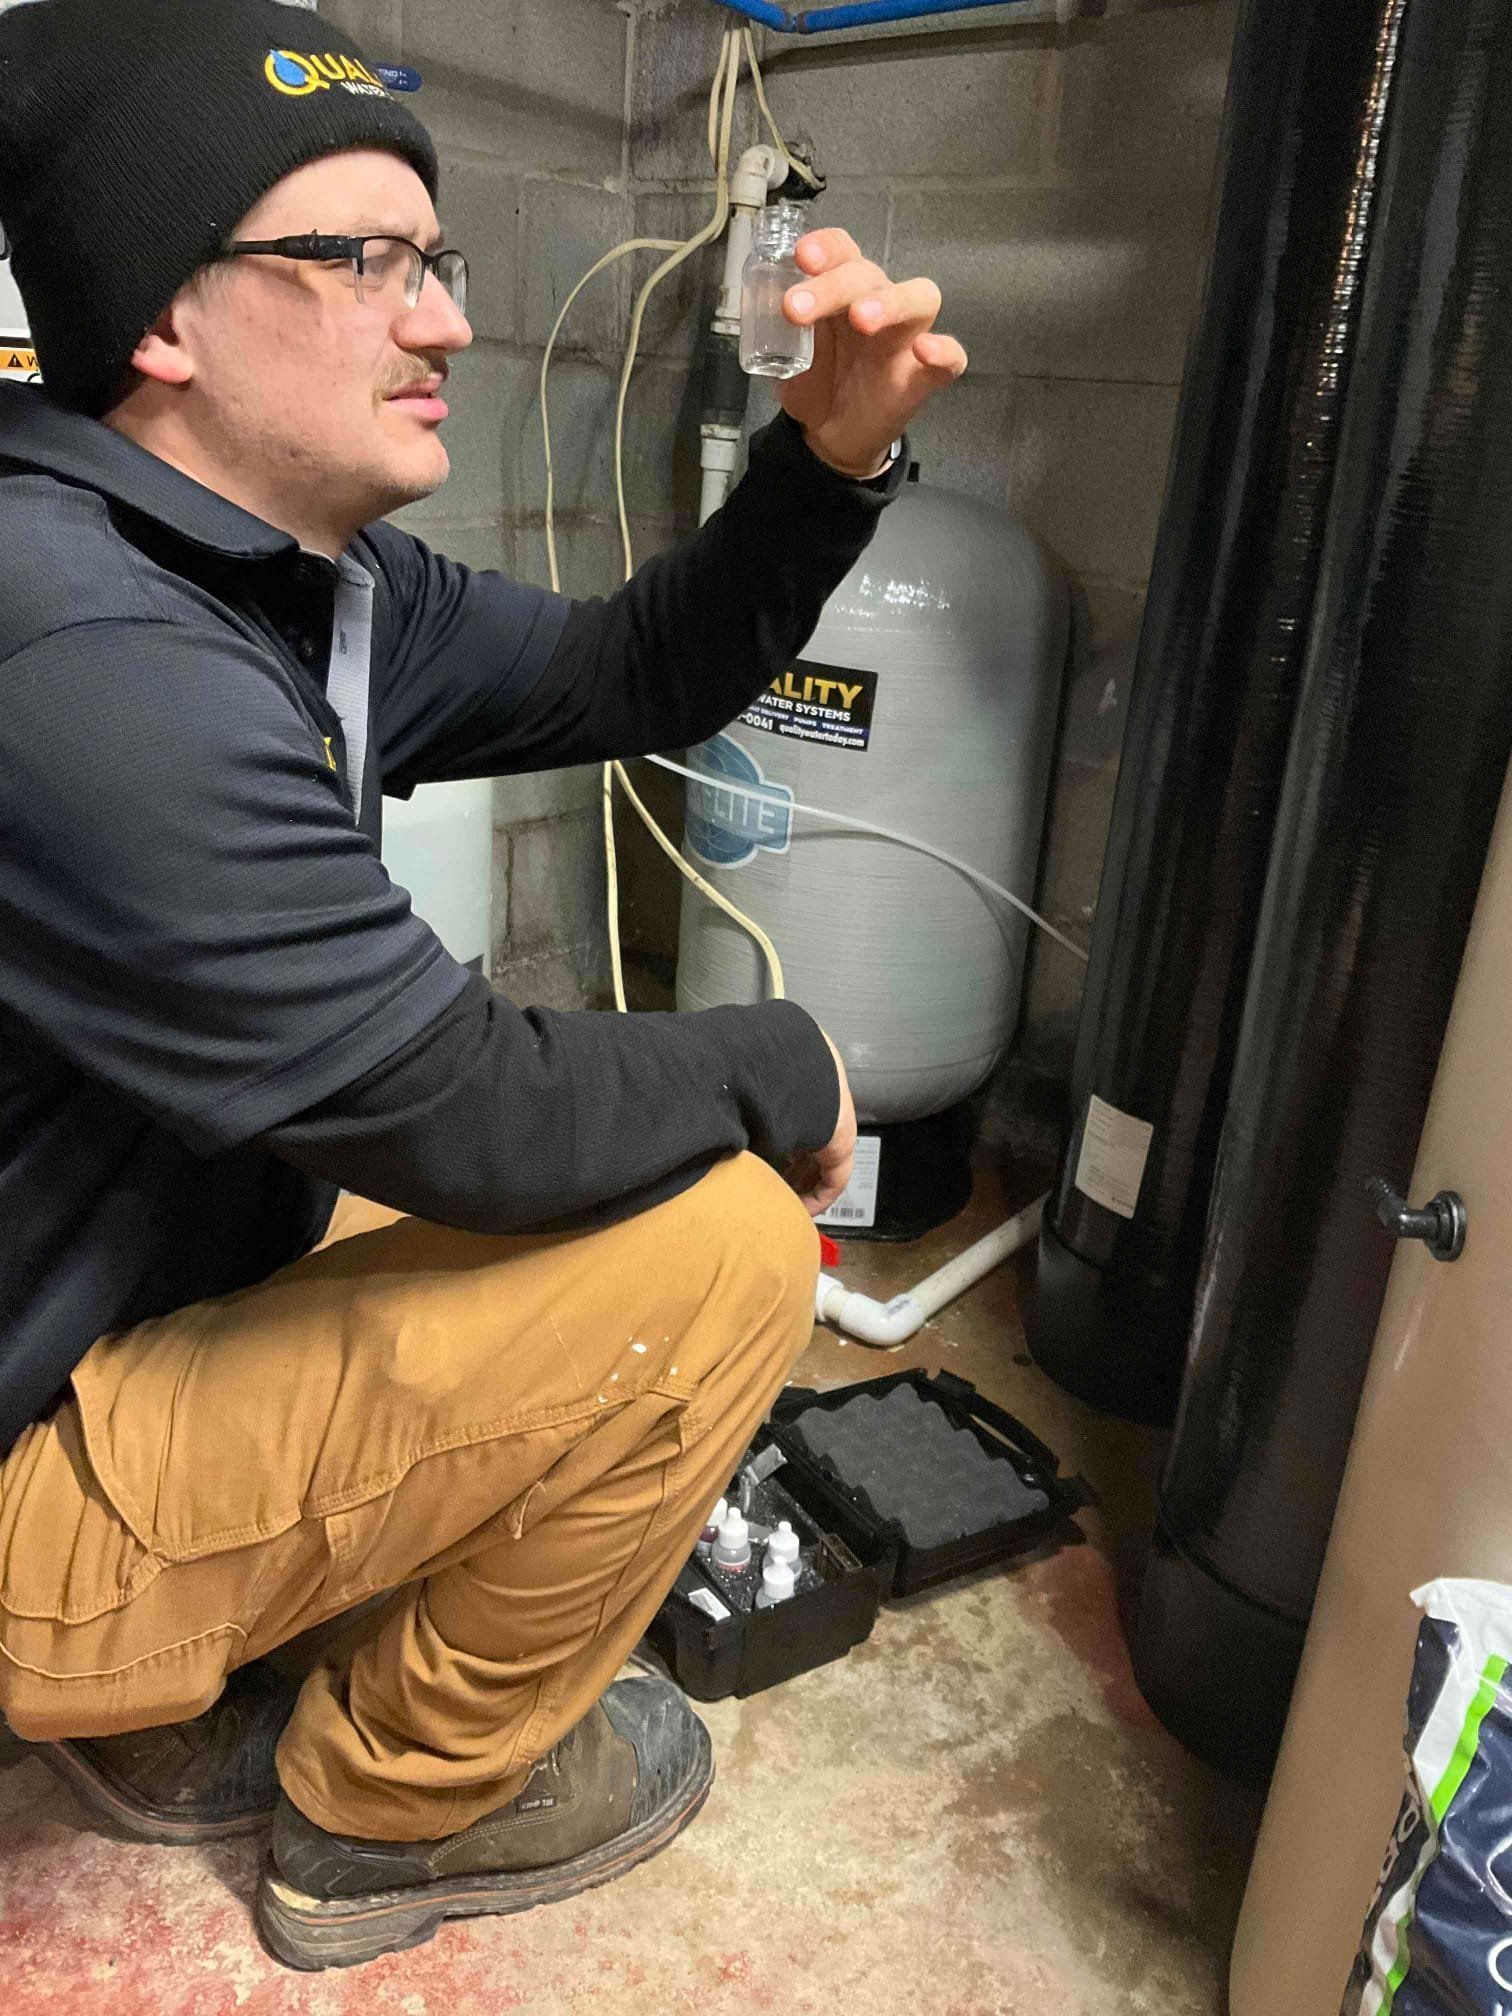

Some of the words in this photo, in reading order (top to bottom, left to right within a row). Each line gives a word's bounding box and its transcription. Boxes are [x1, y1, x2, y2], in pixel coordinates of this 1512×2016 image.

[795, 702, 851, 722] SYSTEMS
[779, 723, 865, 747] qualitywatertoday.com
[793, 717, 817, 727] PUMPS
[822, 723, 863, 735] TREATMENT
